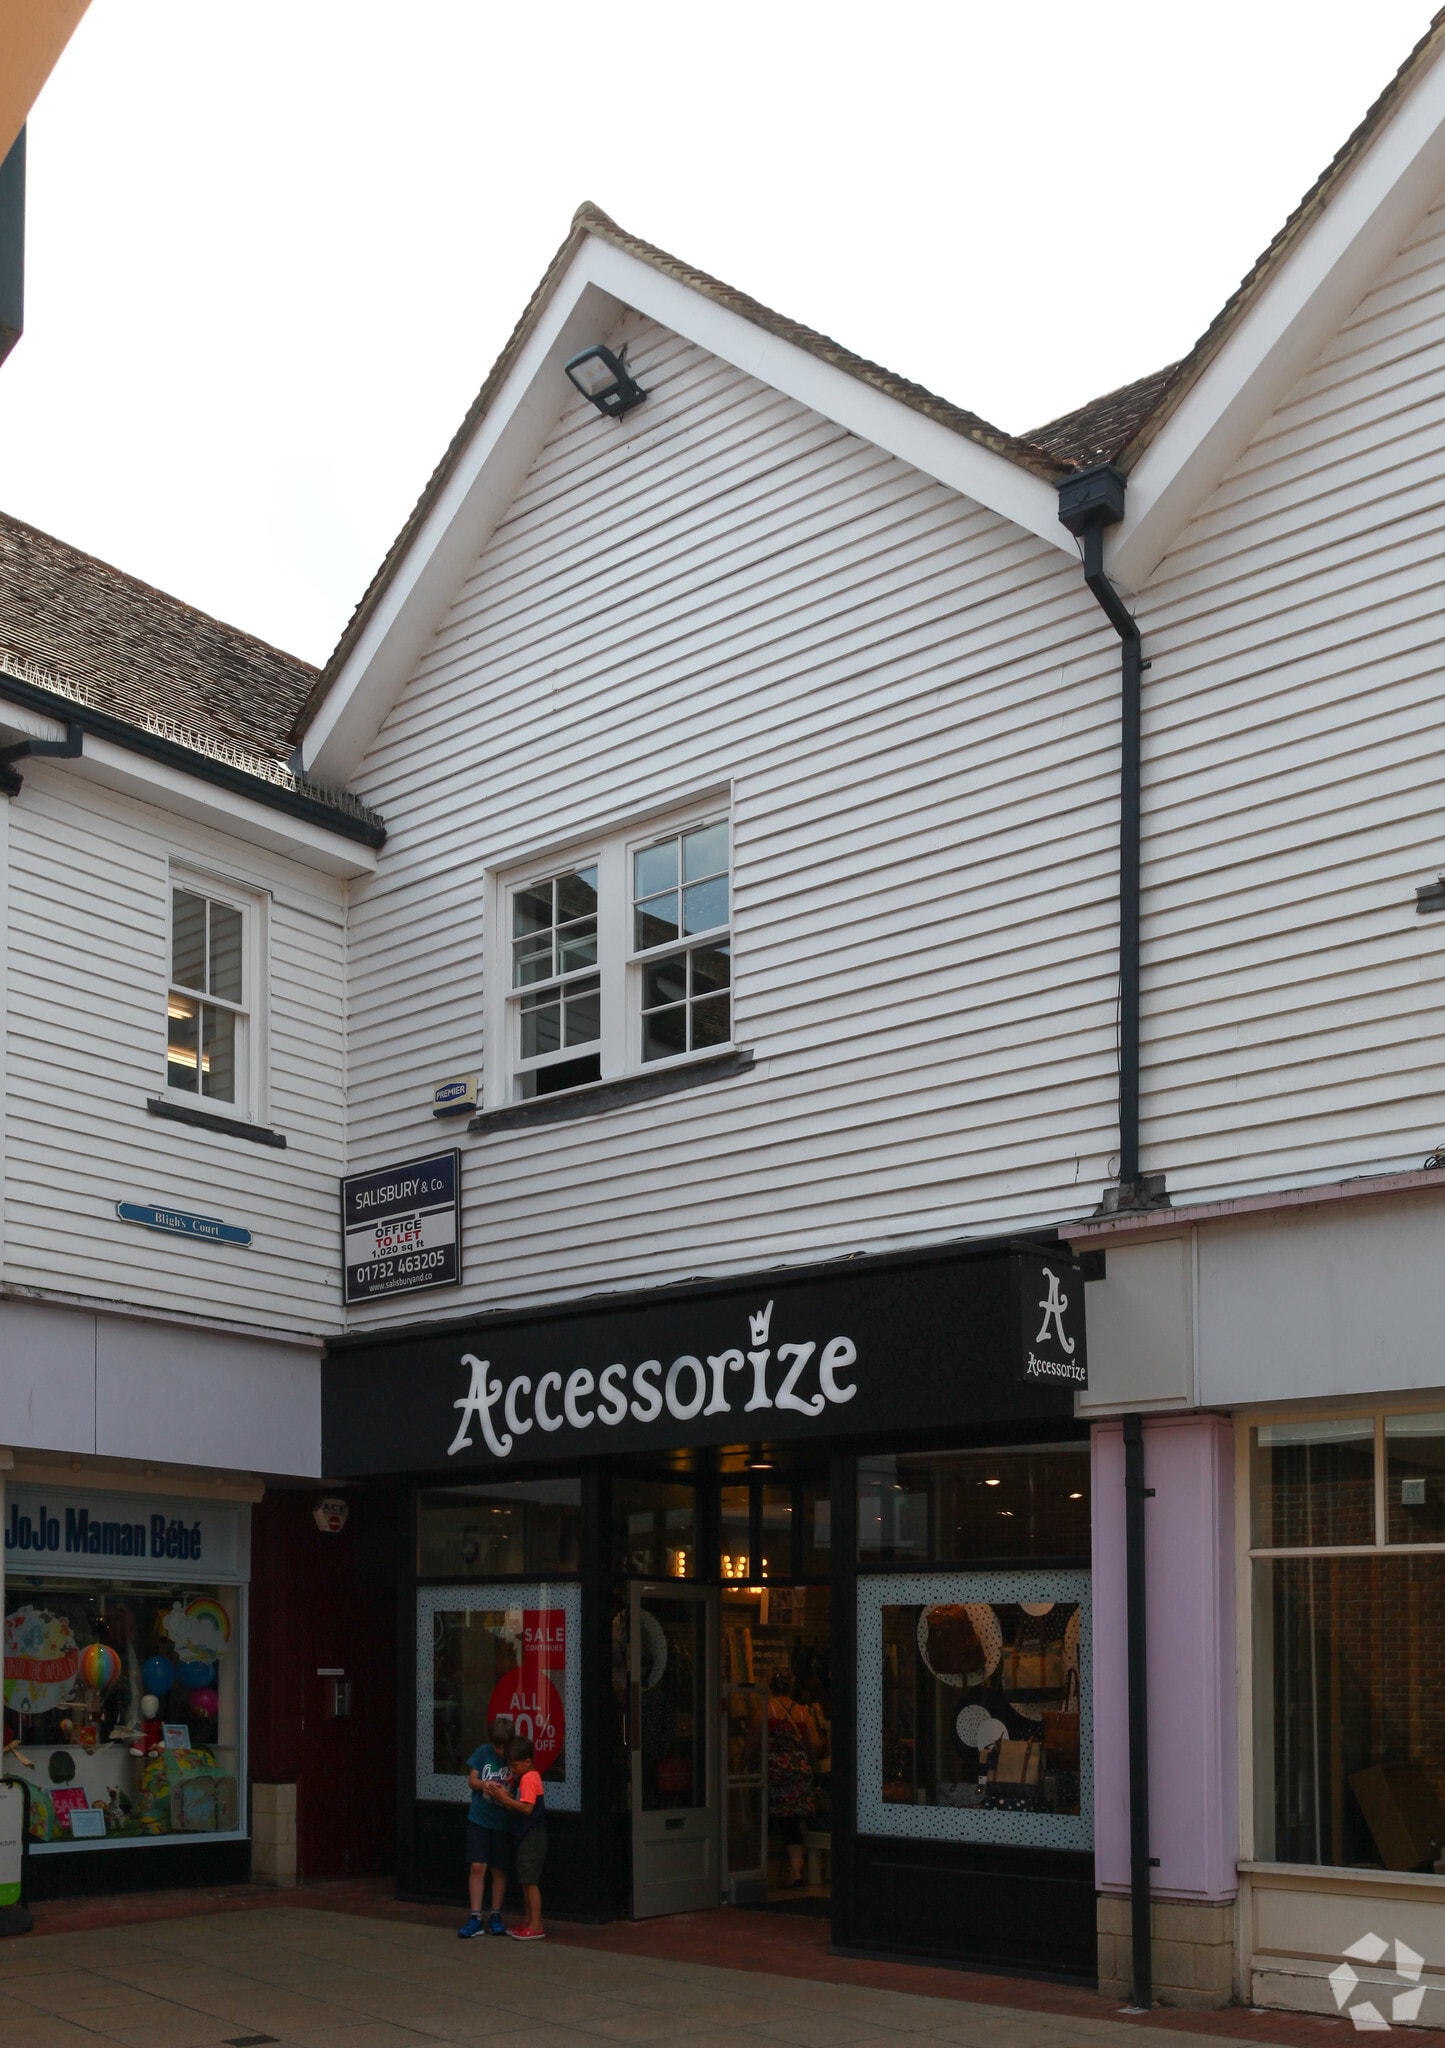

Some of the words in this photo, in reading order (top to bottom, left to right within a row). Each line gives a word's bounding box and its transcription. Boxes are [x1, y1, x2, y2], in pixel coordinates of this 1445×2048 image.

[436, 1085, 466, 1101] PREMIER
[355, 1178, 419, 1210] SALISBURY
[421, 1180, 428, 1194] &
[430, 1178, 445, 1191] Co.
[155, 1212, 186, 1229] Bligh's
[192, 1220, 219, 1236] Court
[375, 1219, 422, 1239] OFFICE
[371, 1245, 398, 1259] 1,020
[401, 1243, 413, 1252] sq
[416, 1239, 425, 1248] ft
[375, 1236, 393, 1249] TO
[397, 1230, 422, 1244] LET
[356, 1261, 394, 1283] 01732
[398, 1250, 445, 1274] 463205
[369, 1273, 433, 1292] www.salisburyand.co
[1035, 1267, 1075, 1354] A
[1026, 1351, 1086, 1381] Accessorize
[446, 1300, 858, 1457] Accessorize
[5, 1503, 60, 1551] JoJo
[65, 1507, 146, 1557] Maman
[151, 1514, 201, 1560] Bébé
[524, 1627, 564, 1642] SALE
[525, 1643, 563, 1652] CONTINUES
[509, 1692, 541, 1711] ALL
[535, 1739, 556, 1752] OFF
